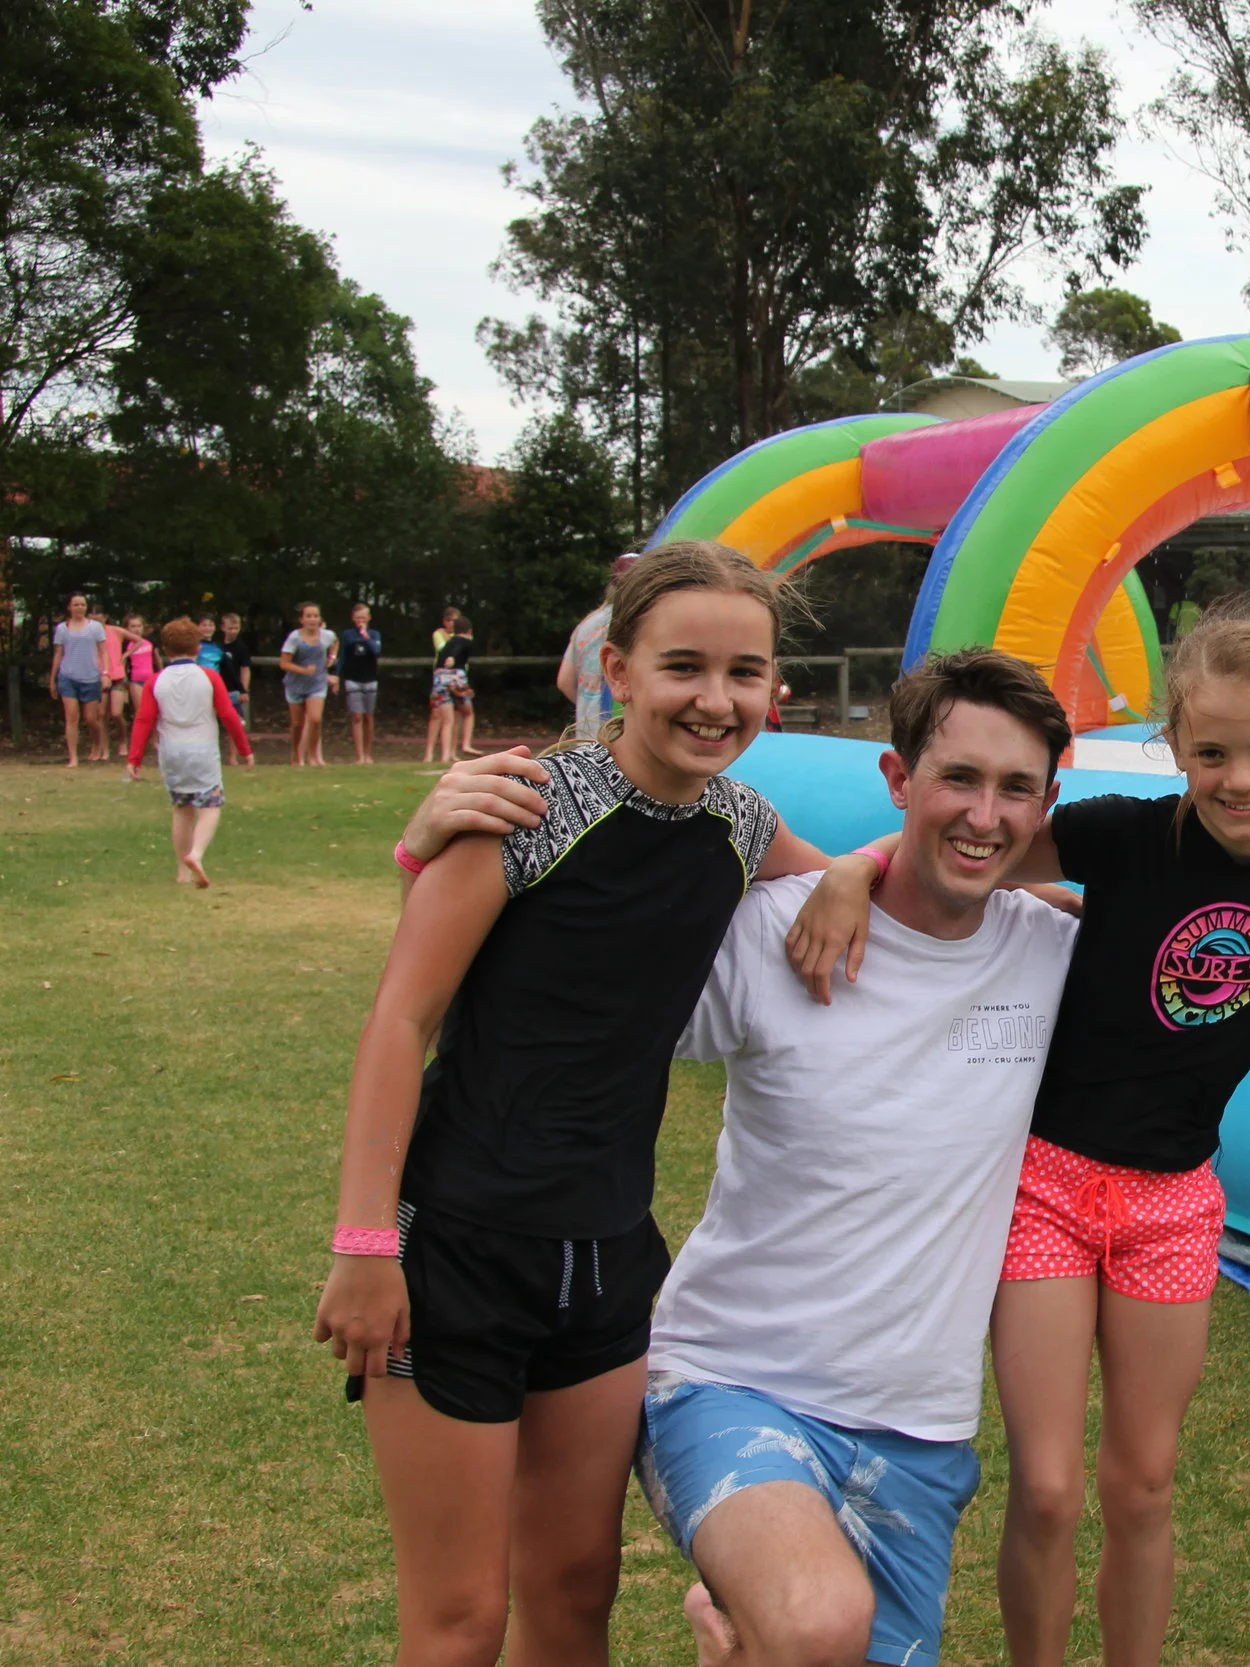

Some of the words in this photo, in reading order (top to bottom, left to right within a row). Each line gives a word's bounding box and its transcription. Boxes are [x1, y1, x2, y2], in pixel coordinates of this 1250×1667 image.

[1167, 950, 1250, 981] SURF
[969, 1004, 982, 1012] IT'S
[947, 1015, 1047, 1051] BELONG
